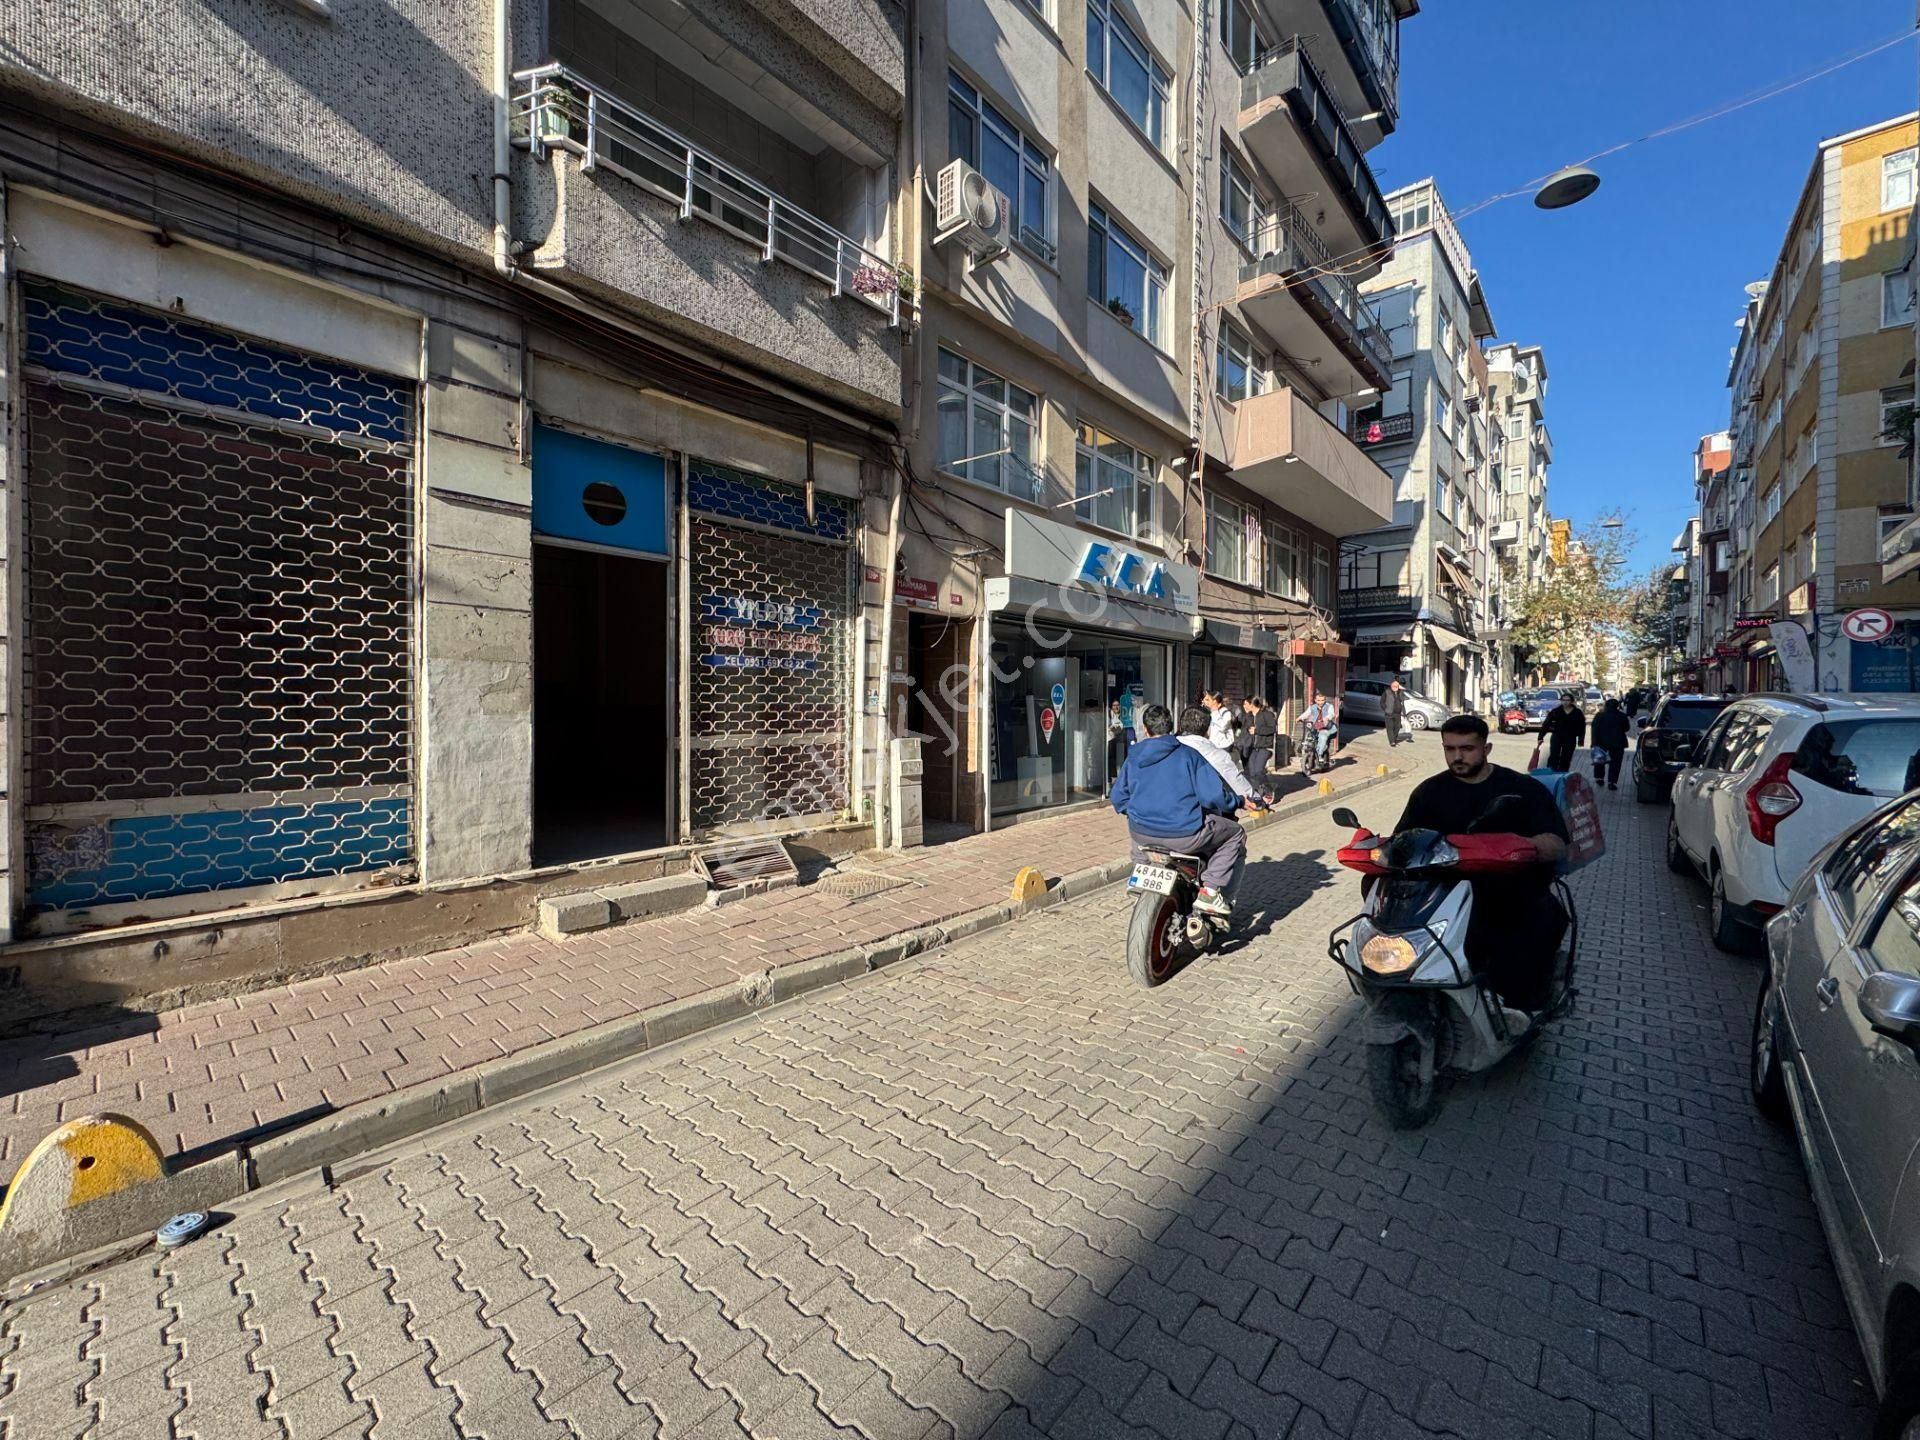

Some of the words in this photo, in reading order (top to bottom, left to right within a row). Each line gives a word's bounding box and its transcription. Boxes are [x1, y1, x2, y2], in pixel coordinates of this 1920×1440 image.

[1136, 865, 1149, 875] 48
[1150, 868, 1173, 881] AAS
[1142, 878, 1163, 890] 986
